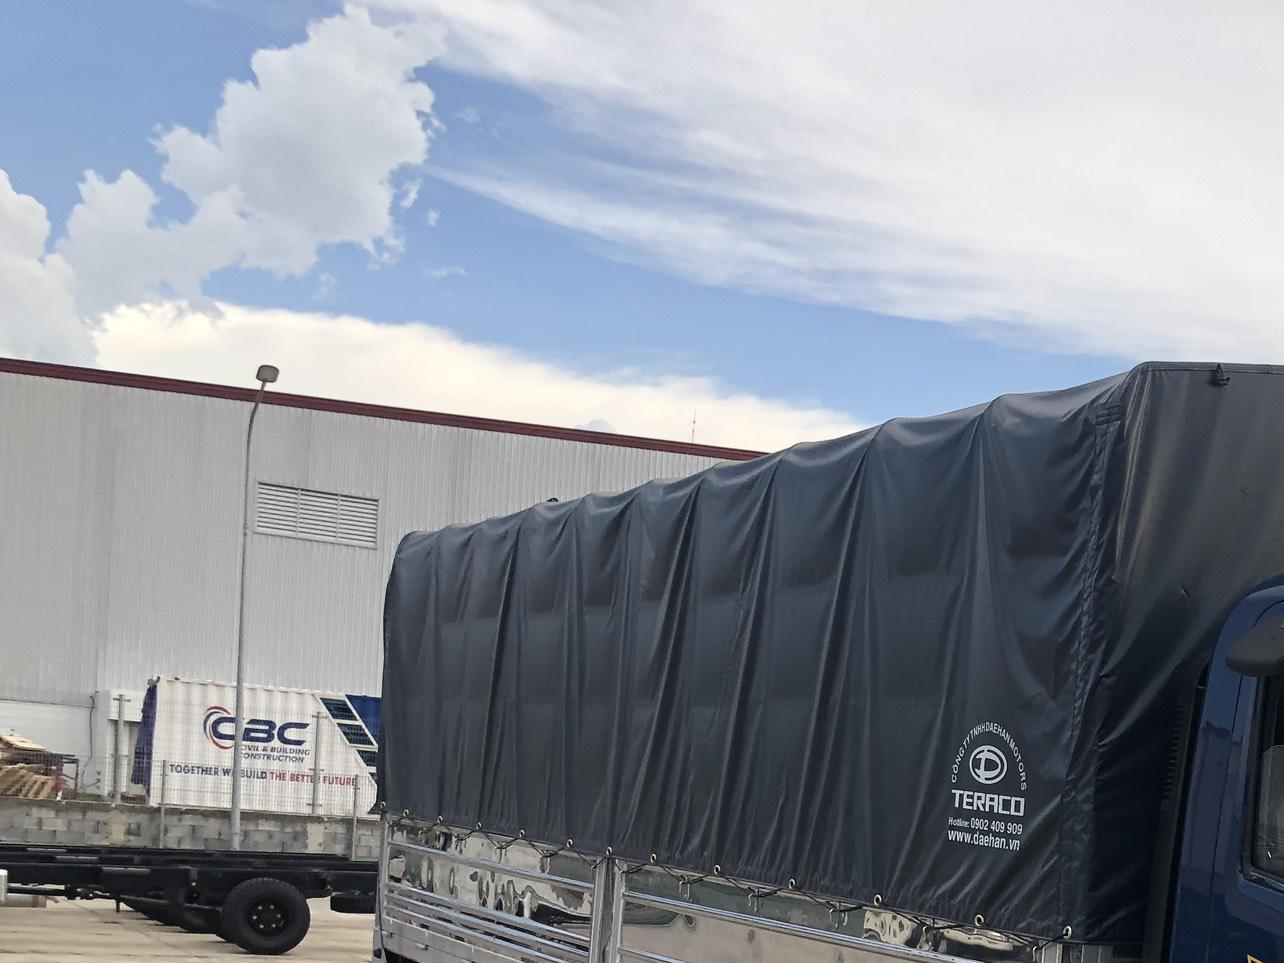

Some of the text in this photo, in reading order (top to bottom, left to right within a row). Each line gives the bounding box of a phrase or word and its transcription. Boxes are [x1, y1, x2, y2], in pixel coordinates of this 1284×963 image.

[211, 716, 309, 746] CBC
[270, 746, 310, 756] BUILDING
[963, 734, 970, 749] TY
[970, 722, 986, 739] TNHH
[985, 721, 1010, 744] DAEHAN
[1009, 738, 1027, 791] MOTORS
[169, 763, 219, 776] TOGETHER
[269, 771, 286, 782] THE
[951, 789, 1025, 817] TERACO
[970, 817, 989, 831] 0902
[990, 820, 1005, 833] 409
[1006, 822, 1023, 835] 909
[947, 830, 1021, 851] www.daehan.vn
